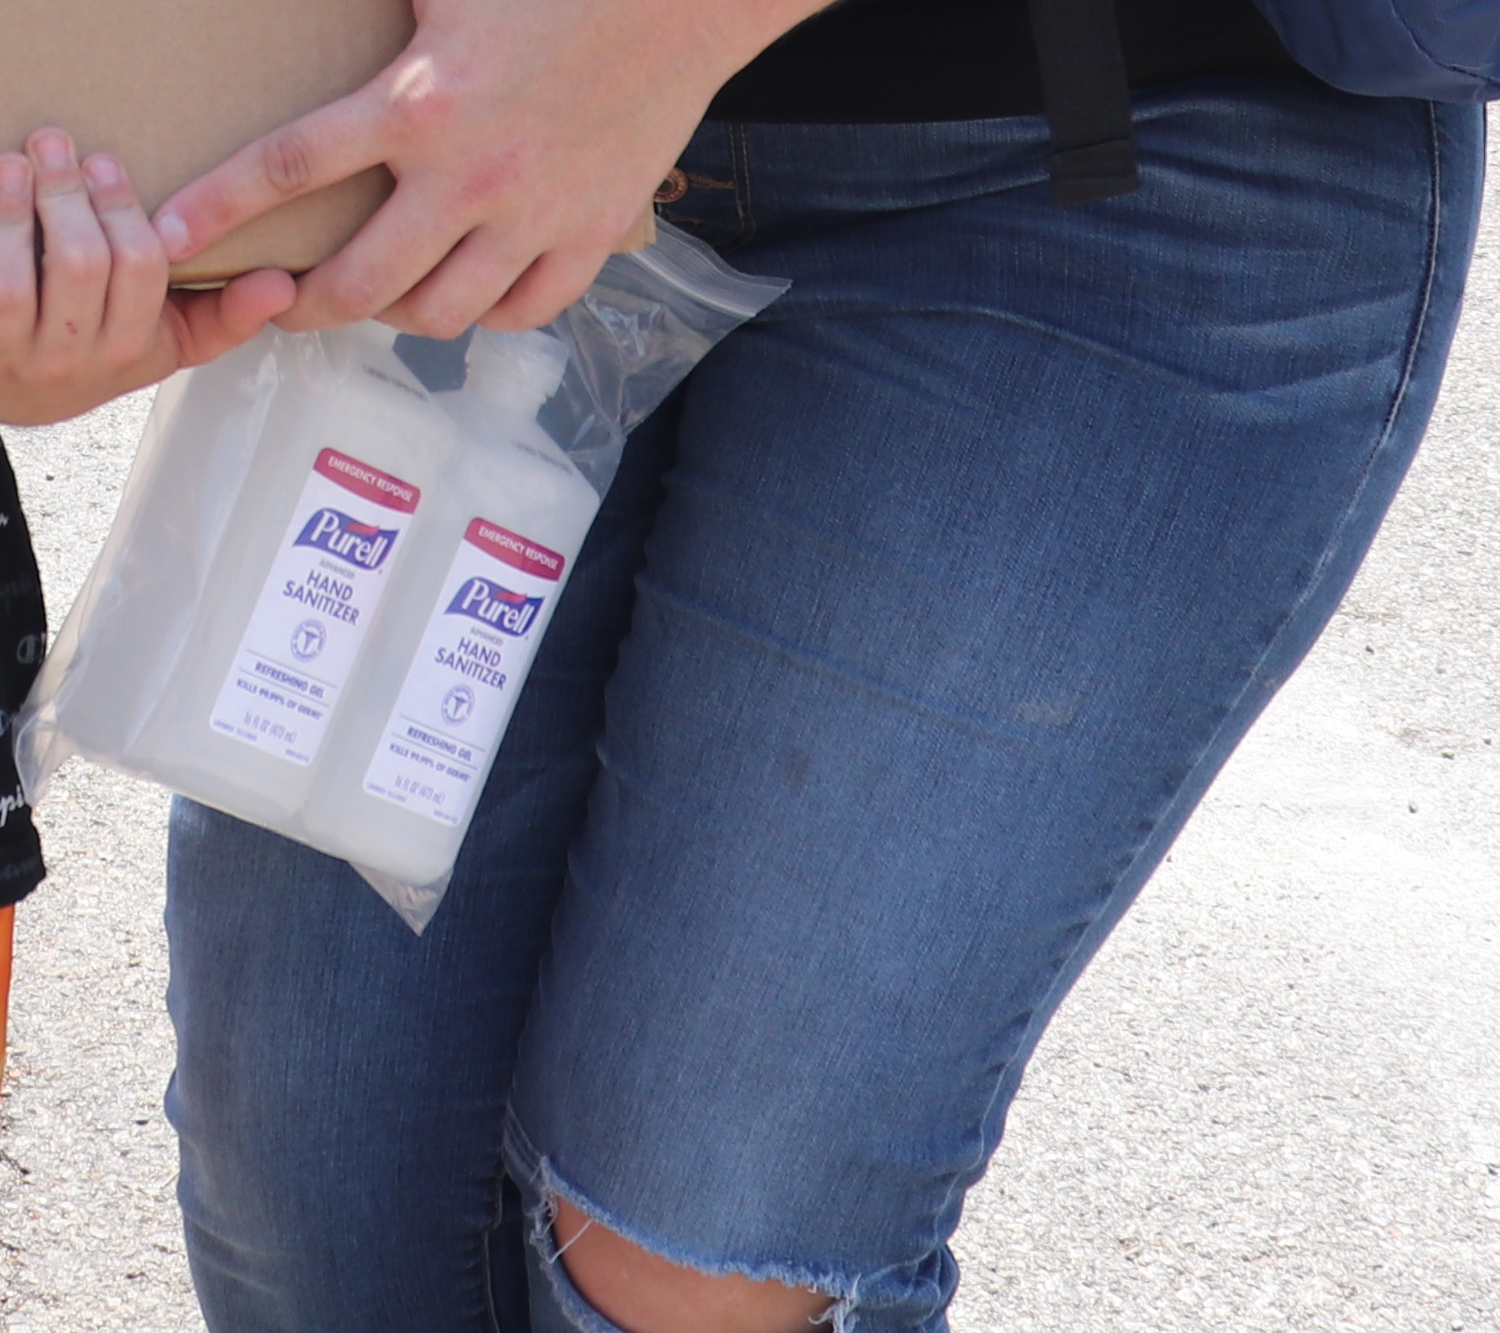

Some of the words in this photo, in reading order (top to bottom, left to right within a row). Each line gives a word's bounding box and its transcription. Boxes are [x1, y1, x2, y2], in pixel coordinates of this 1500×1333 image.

[328, 455, 377, 485] EMERGENCY
[376, 478, 413, 503] RESPONSE
[309, 509, 389, 569] Purell
[478, 525, 525, 555] EMERGENCY
[525, 546, 559, 571] RESPONSE
[282, 580, 360, 626] SANITIZER
[306, 569, 353, 602] HAND
[460, 579, 535, 634] Purell
[434, 647, 507, 691] SANITIZER
[457, 636, 502, 668] HAND
[236, 678, 258, 694] KILLS
[286, 699, 298, 710] OF
[254, 661, 310, 692] REFRESHING
[309, 684, 326, 700] GEL
[389, 743, 410, 759] KILLS
[435, 762, 447, 773] OF
[406, 726, 458, 756] REFRESHING
[457, 747, 474, 763] GEL
